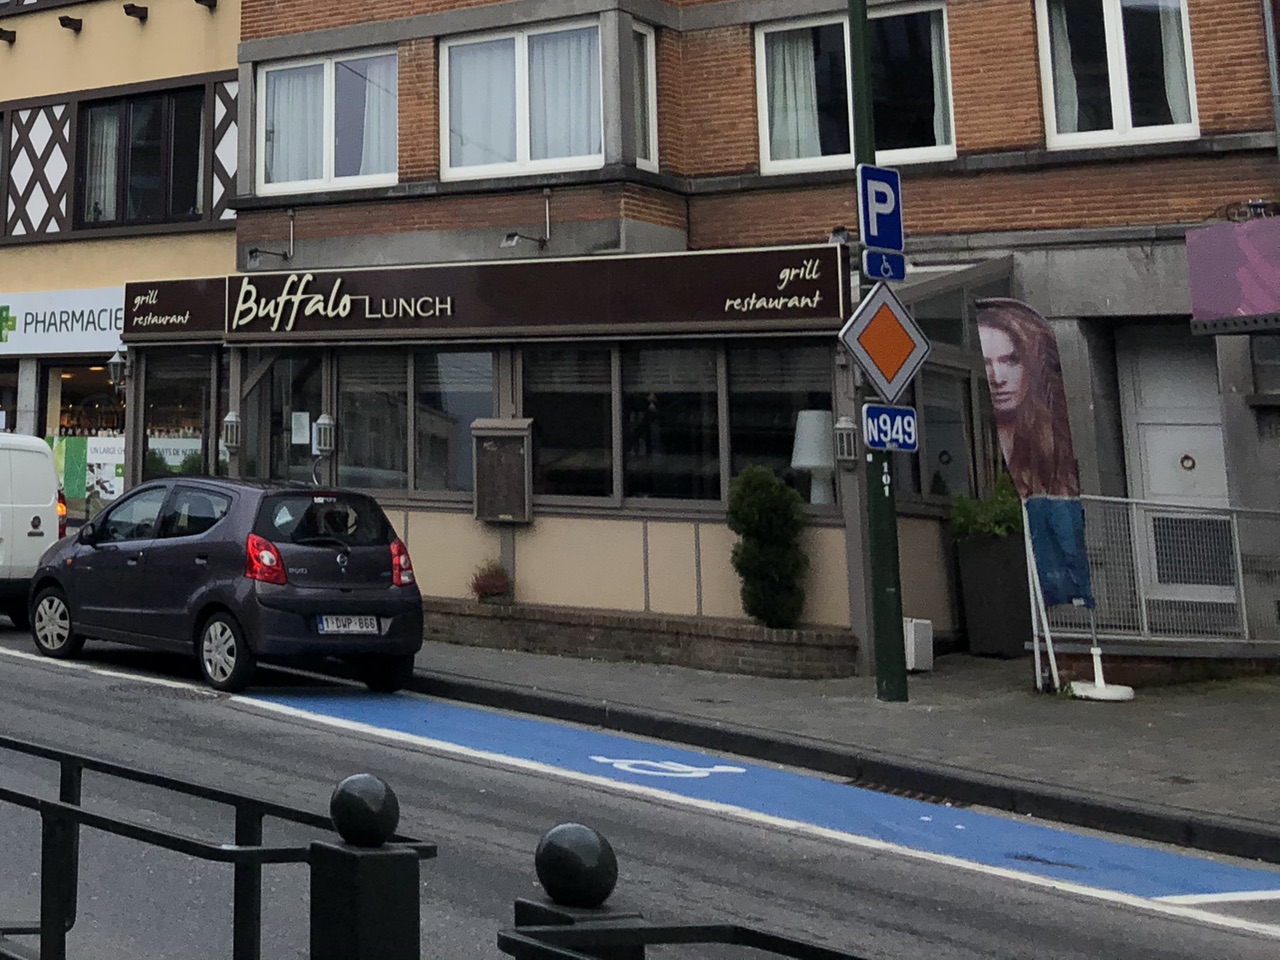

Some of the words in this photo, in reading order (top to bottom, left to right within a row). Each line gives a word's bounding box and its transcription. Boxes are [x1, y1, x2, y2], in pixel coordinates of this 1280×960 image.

[867, 179, 895, 236] P
[777, 259, 821, 290] grill
[132, 290, 158, 312] grill
[232, 273, 351, 331] Buffalo
[365, 296, 452, 318] LUNCH
[724, 290, 824, 312] restaurant
[23, 307, 124, 334] PHARMACIE
[132, 311, 190, 327] restaurant
[867, 413, 916, 445] N949
